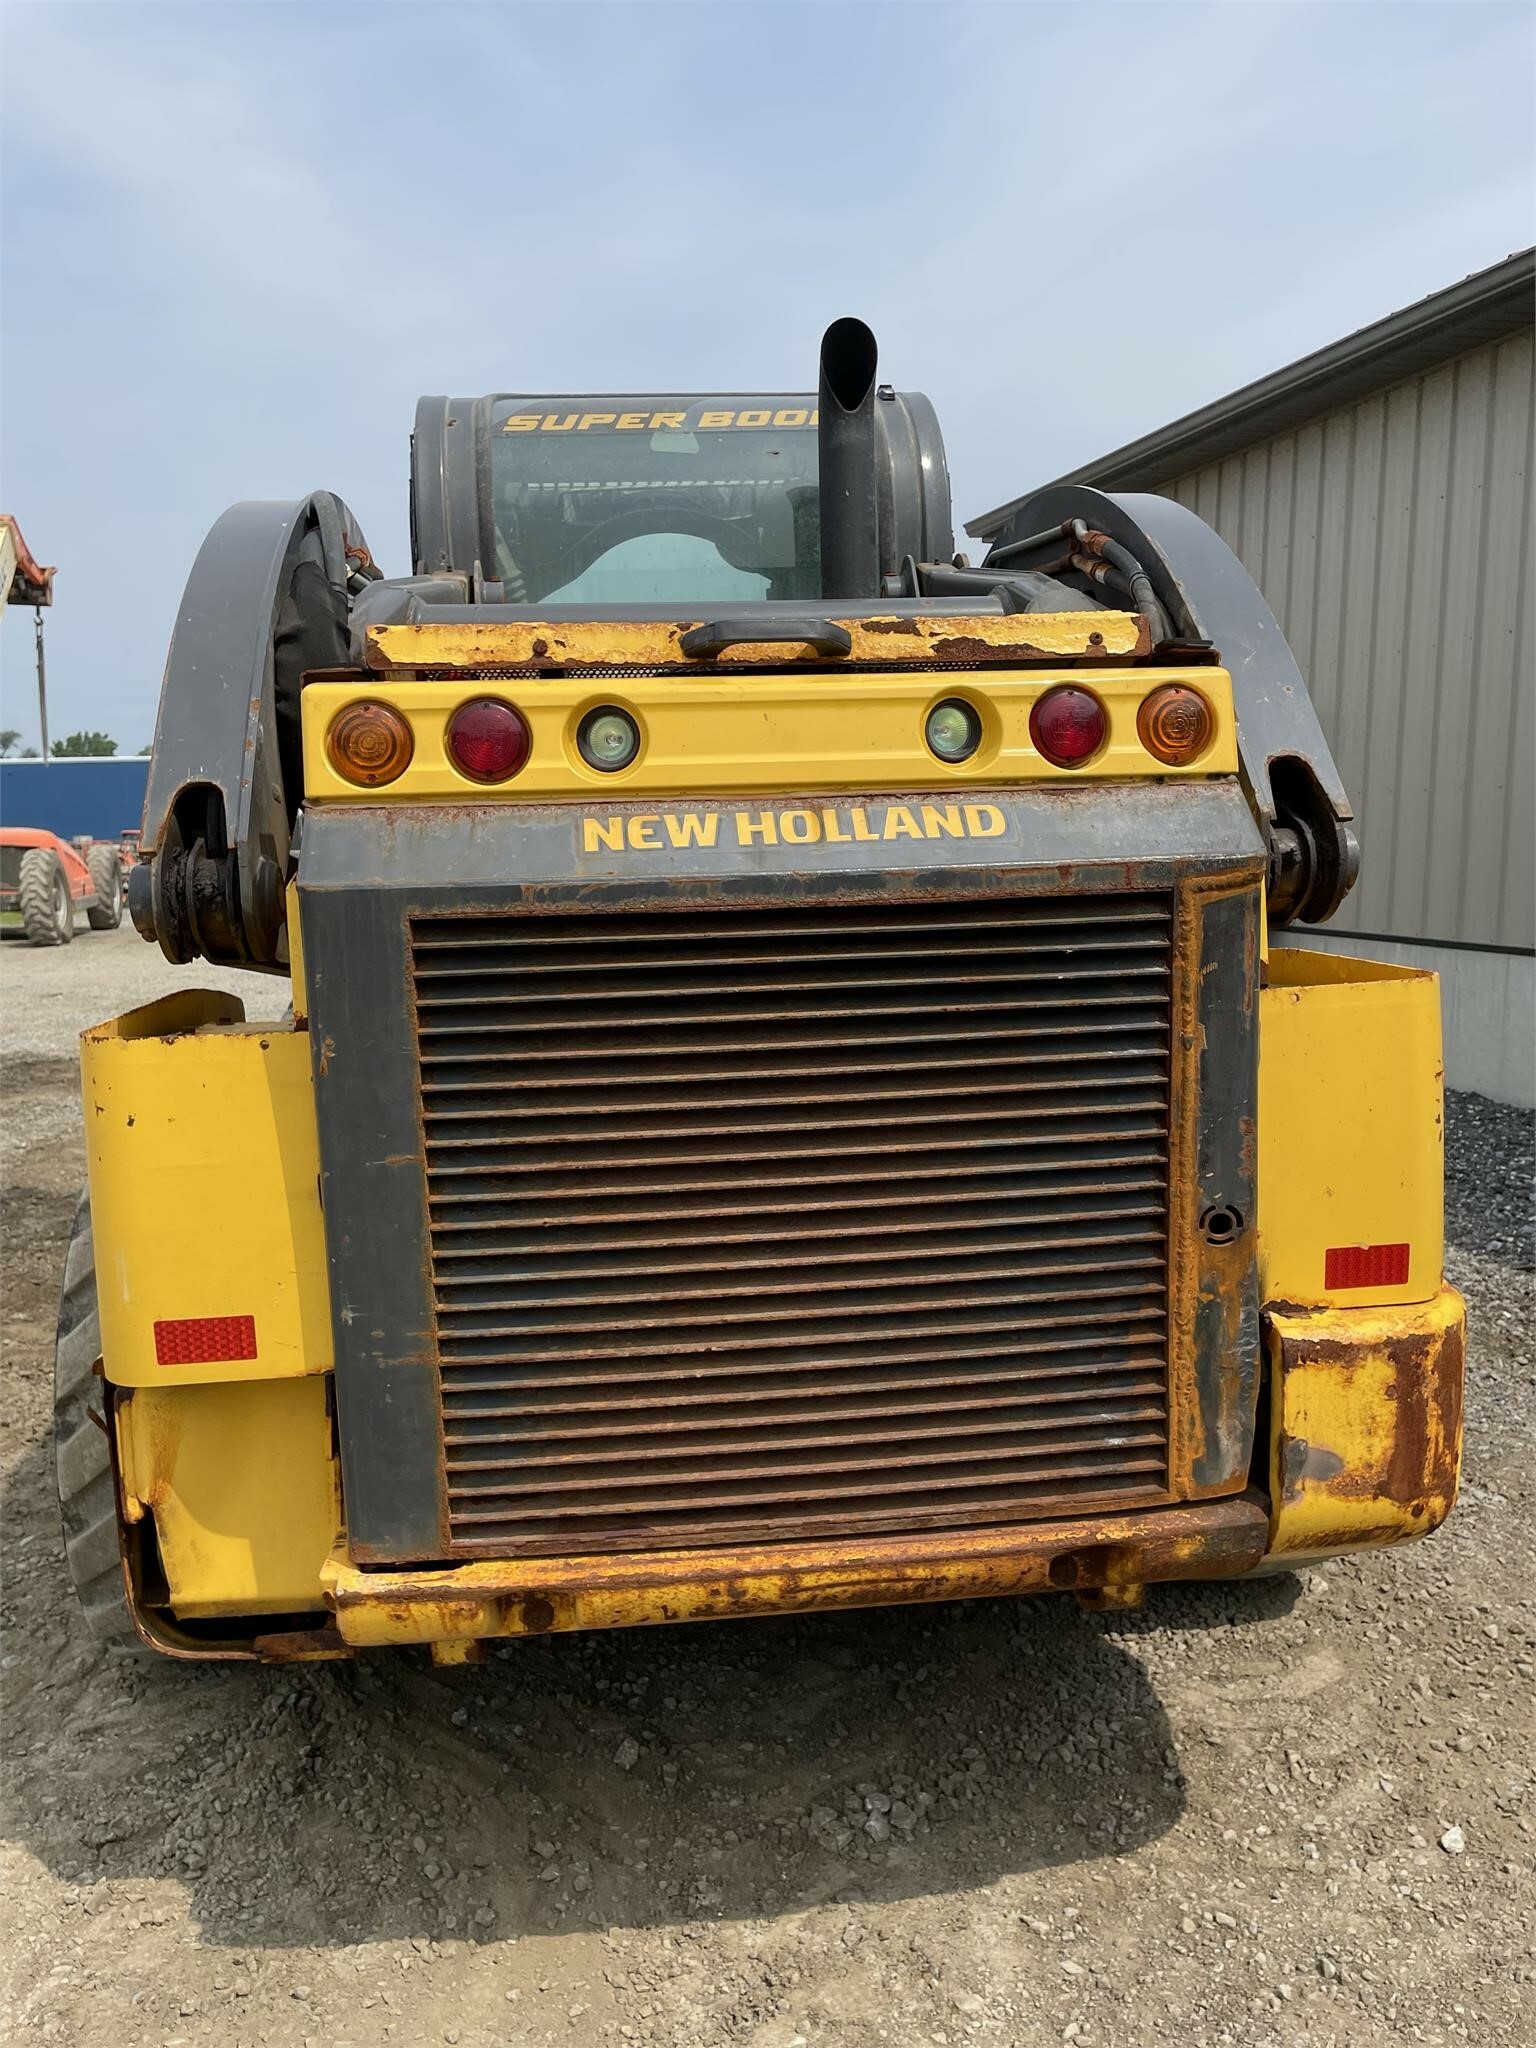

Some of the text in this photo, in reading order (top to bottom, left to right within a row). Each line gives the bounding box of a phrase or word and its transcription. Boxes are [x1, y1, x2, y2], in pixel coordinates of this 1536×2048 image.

[502, 409, 819, 432] SUPER BOO
[583, 804, 1007, 852] NEW HOLLAND
